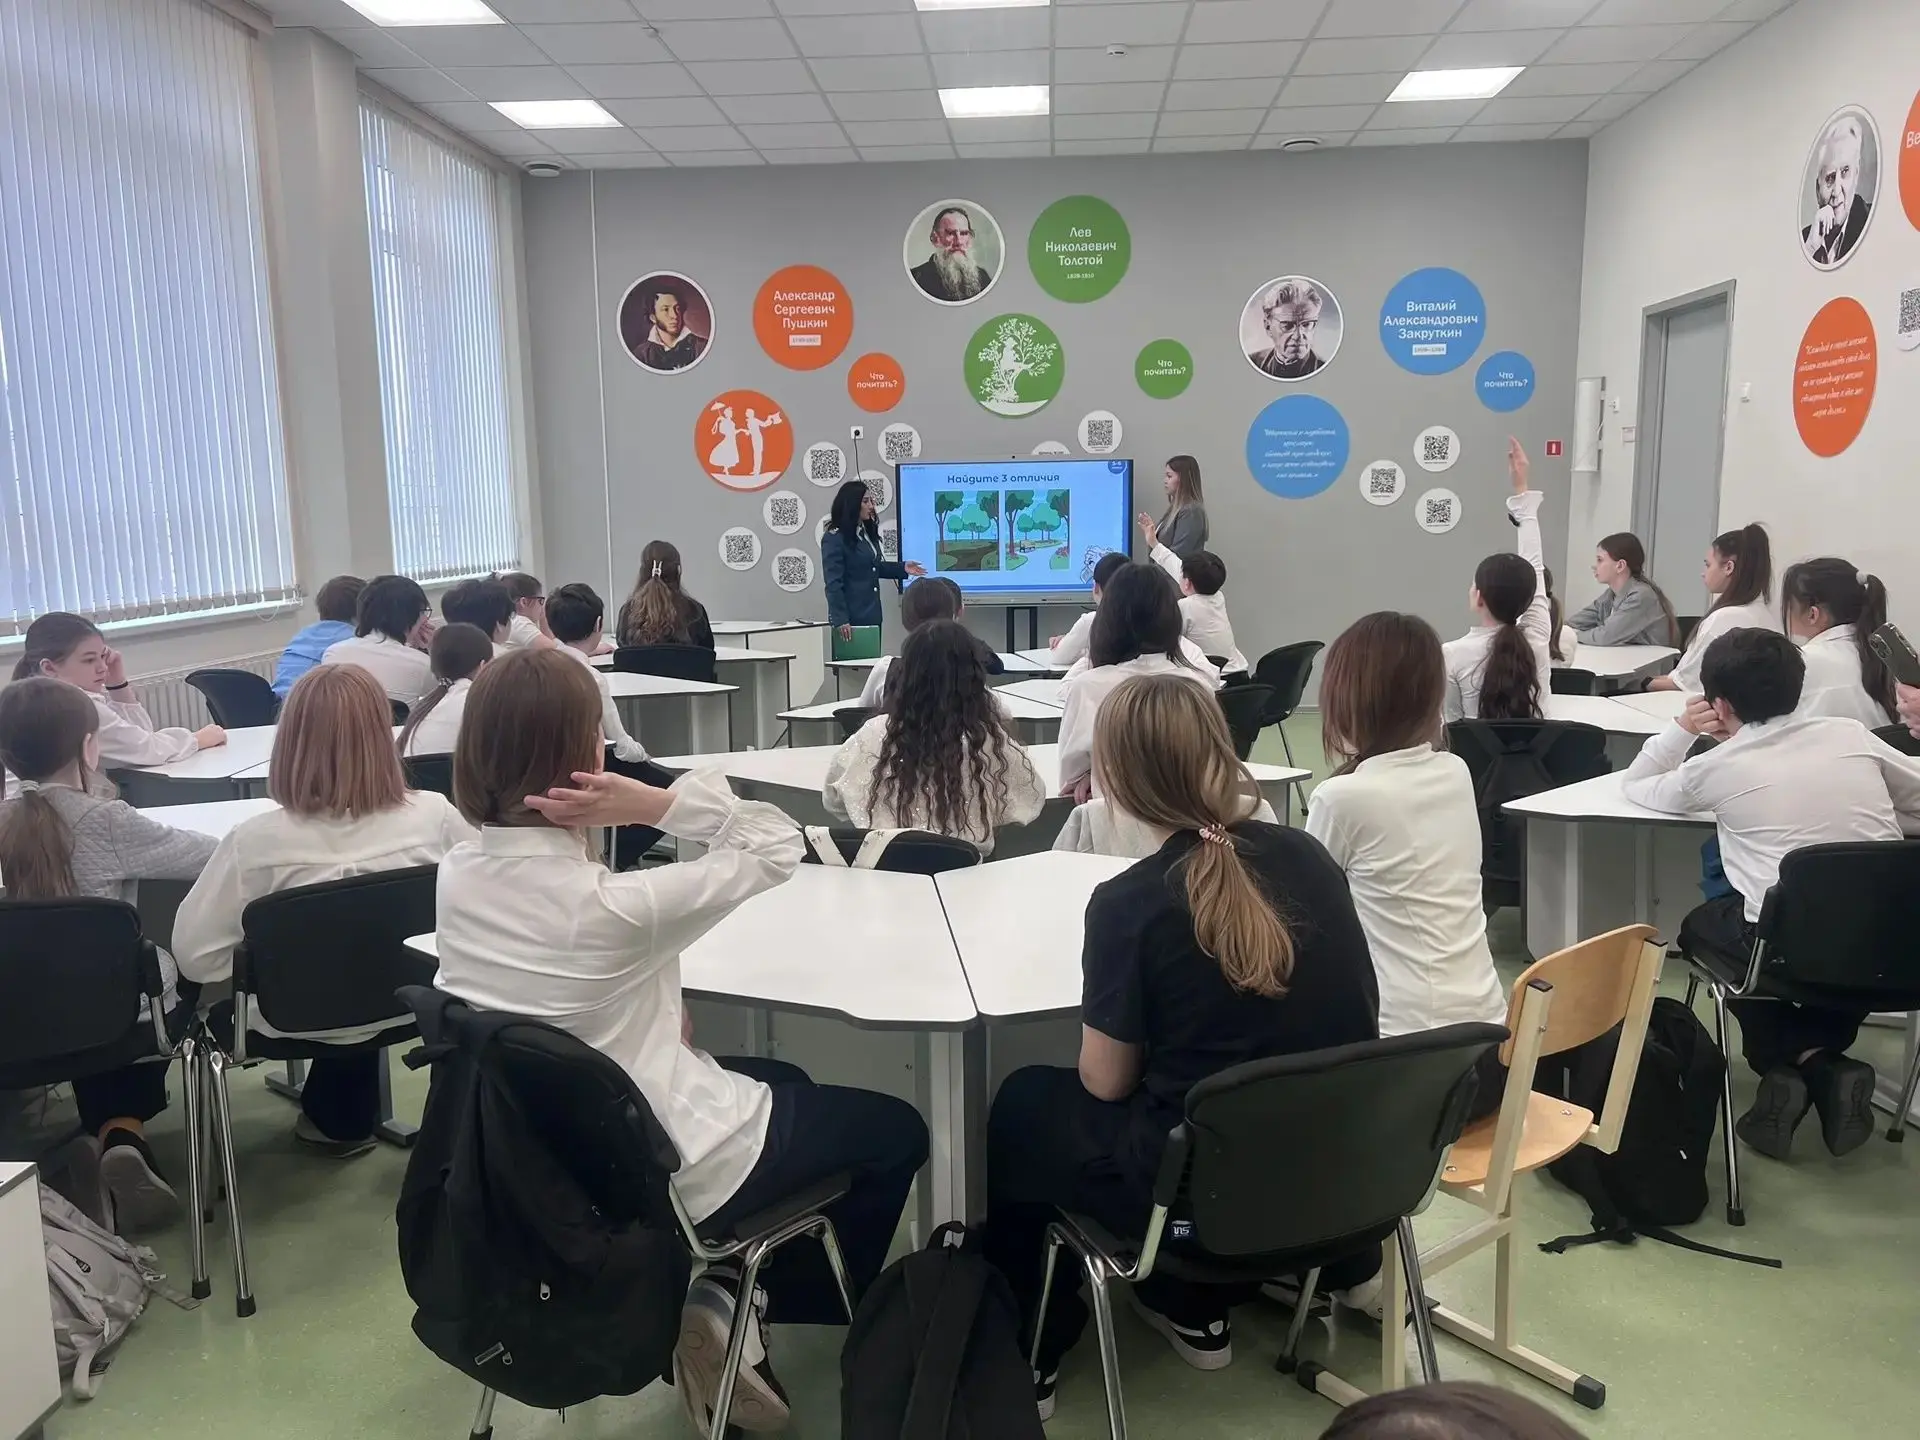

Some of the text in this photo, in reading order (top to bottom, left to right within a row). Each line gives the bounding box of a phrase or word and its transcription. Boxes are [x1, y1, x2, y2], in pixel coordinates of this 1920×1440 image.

[1070, 227, 1092, 238] Лев
[1045, 241, 1117, 252] Николаевич
[1058, 254, 1103, 266] Толстой
[773, 291, 835, 302] Александр
[774, 304, 835, 316] Сергеевич
[1406, 300, 1457, 312] Виталий
[782, 317, 828, 330] Пушкин
[1384, 315, 1478, 326] Александрович
[1398, 328, 1462, 341] Закруткин
[1157, 359, 1173, 368] Что
[869, 371, 885, 380] Что
[1144, 366, 1187, 377] почитать?
[1498, 371, 1514, 380] Что
[856, 379, 898, 389] почитать?
[1484, 378, 1529, 388] почитать?
[947, 474, 1060, 485] Найдите 3 отличия
